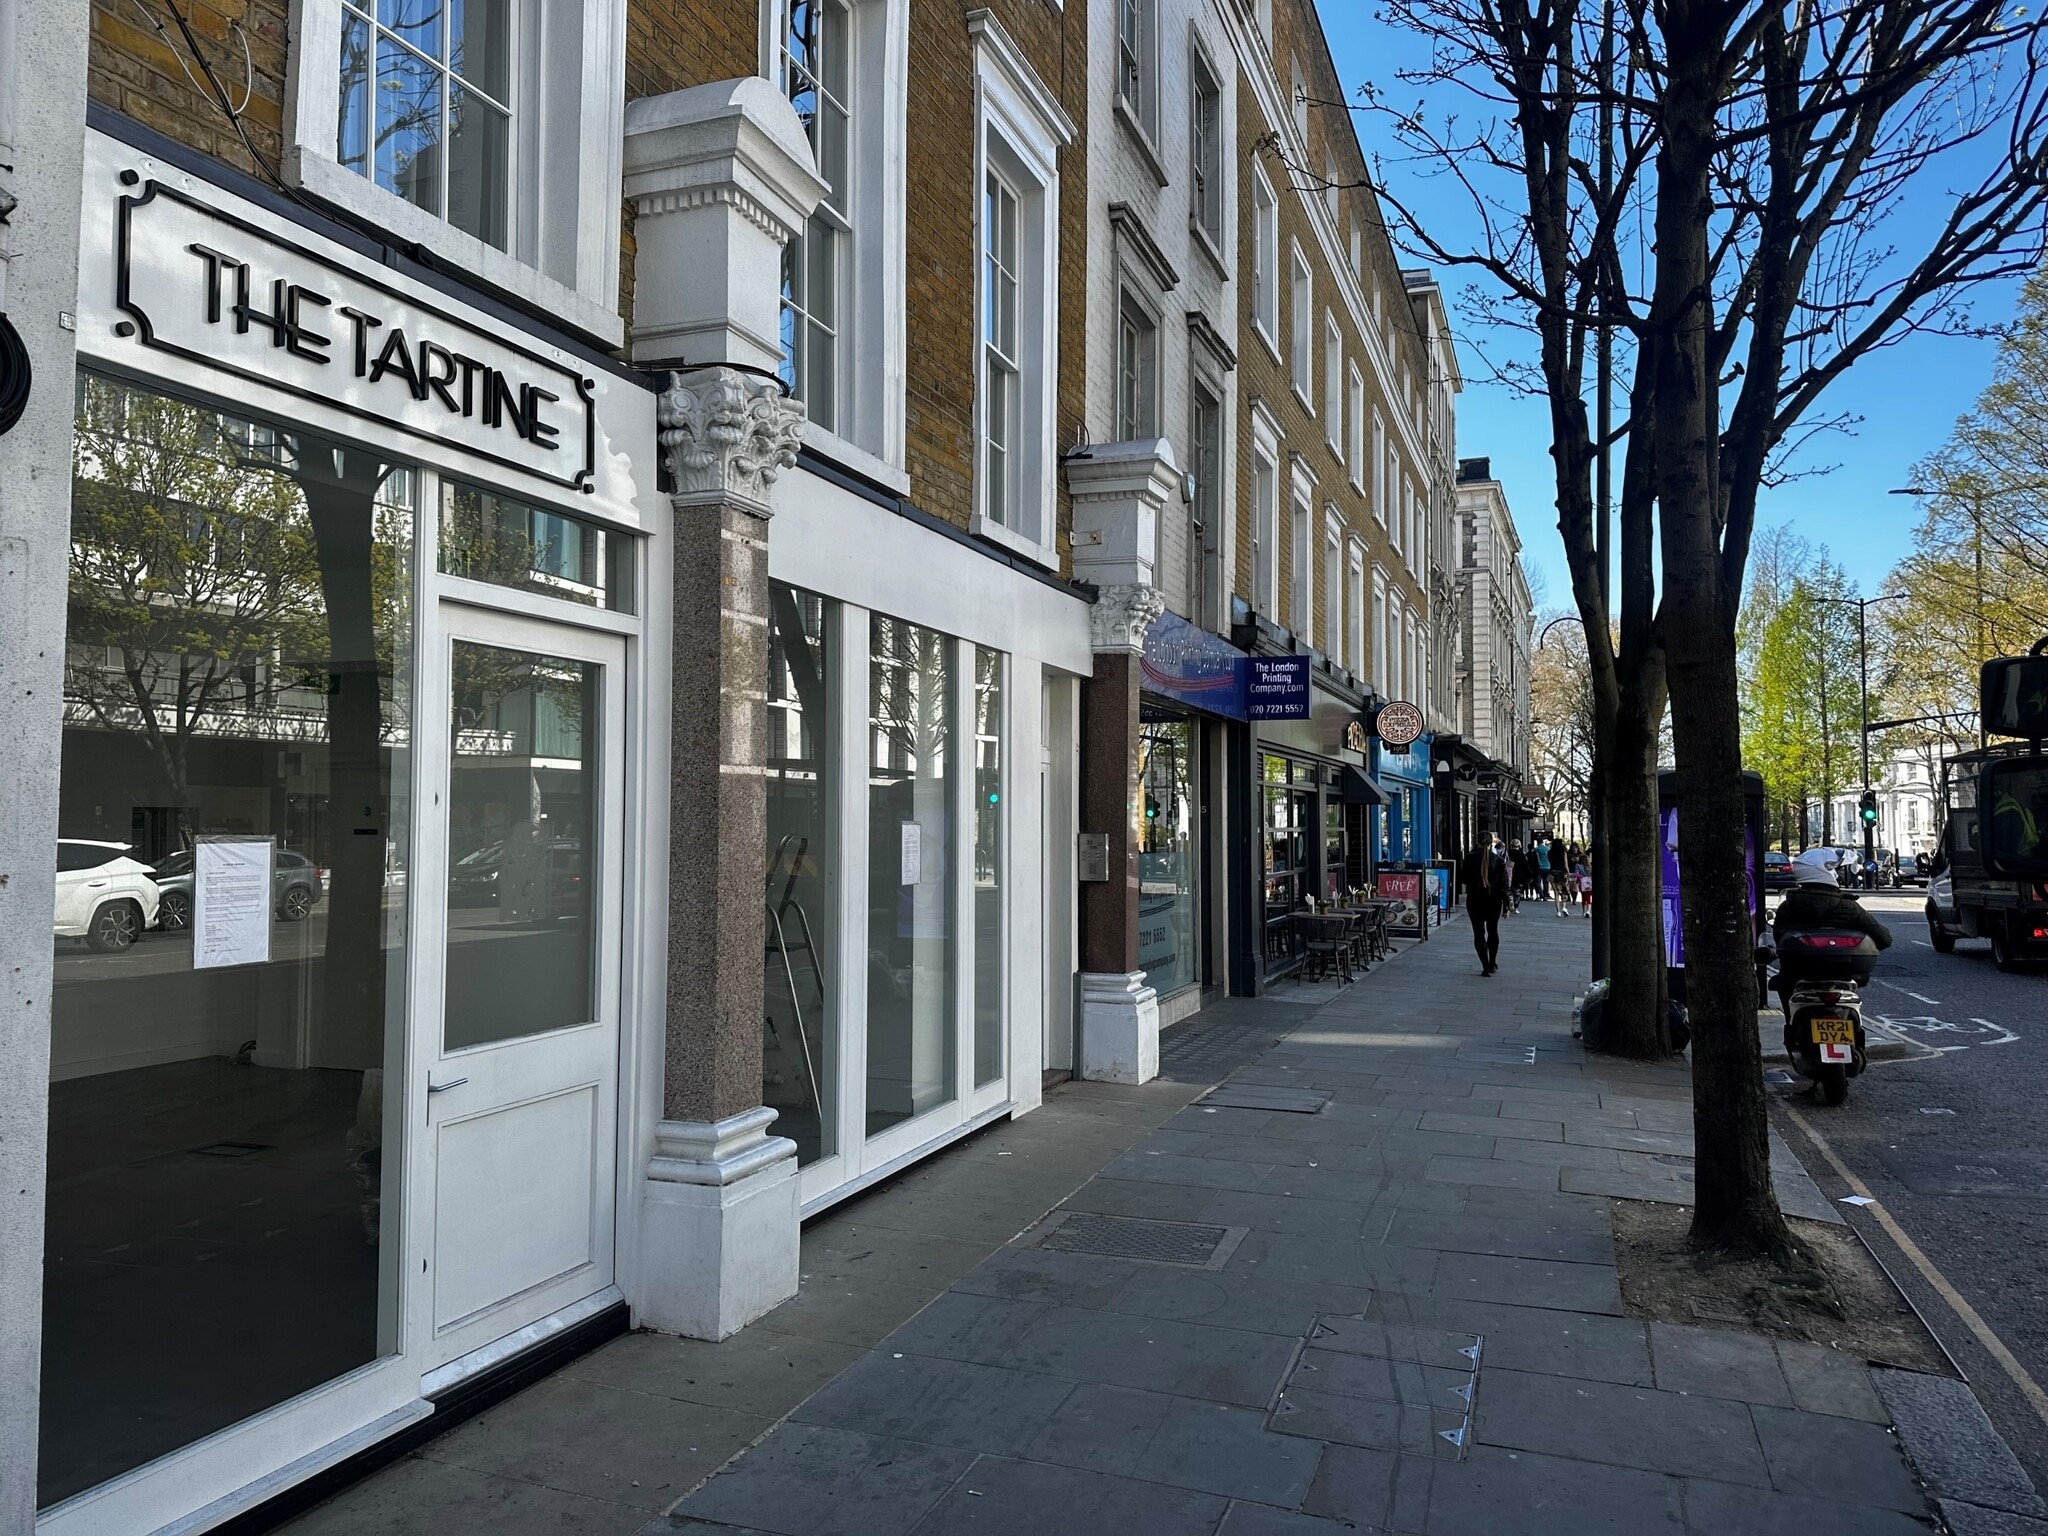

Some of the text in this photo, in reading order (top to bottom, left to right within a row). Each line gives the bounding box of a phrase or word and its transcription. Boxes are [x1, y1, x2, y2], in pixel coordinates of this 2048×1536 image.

[190, 243, 560, 450] THE TARTINE
[1255, 662, 1299, 672] The London
[1262, 673, 1292, 684] Printing
[1250, 683, 1304, 695] Company.com
[1250, 705, 1264, 714] 020
[1266, 705, 1283, 714] 7221
[1285, 704, 1304, 714] 5552
[1384, 880, 1415, 893] FREE
[1139, 926, 1166, 947] 7221 5552
[1816, 1020, 1849, 1032] KR21
[1820, 1031, 1847, 1042] DYA
[1826, 1043, 1845, 1058] L
